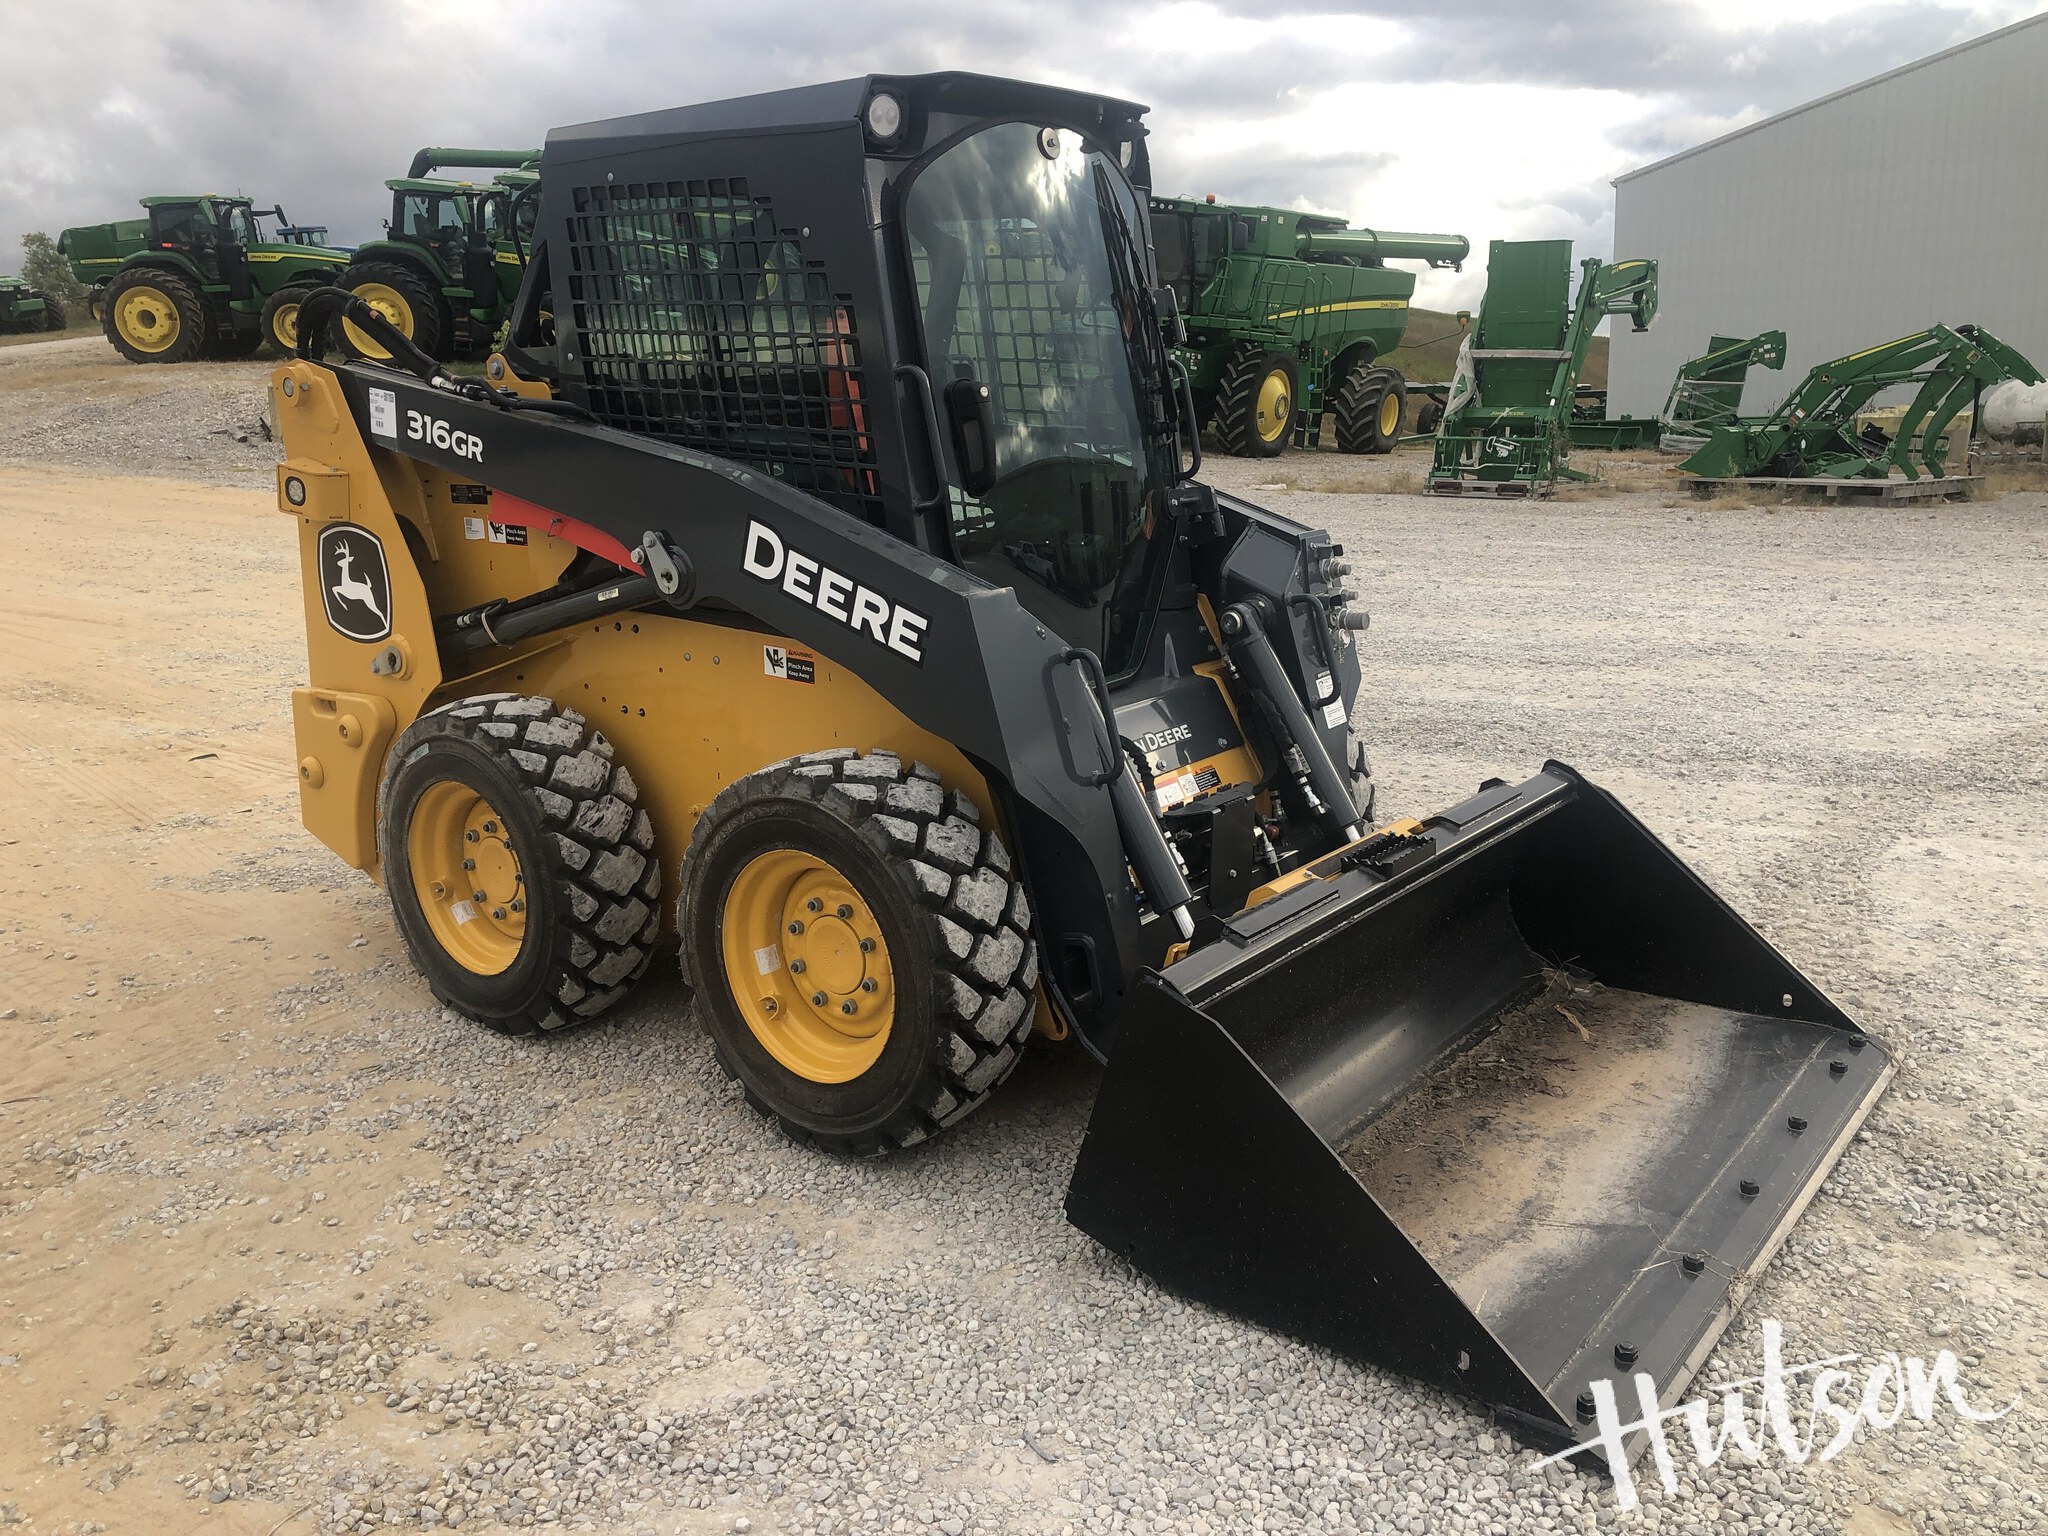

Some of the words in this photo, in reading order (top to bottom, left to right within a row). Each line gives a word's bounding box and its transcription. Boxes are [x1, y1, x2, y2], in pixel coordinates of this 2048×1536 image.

[407, 409, 483, 463] 316GR
[743, 519, 928, 662] DEERE
[788, 661, 801, 670] Pinch
[801, 664, 813, 672] Area
[1144, 724, 1192, 751] DEERE
